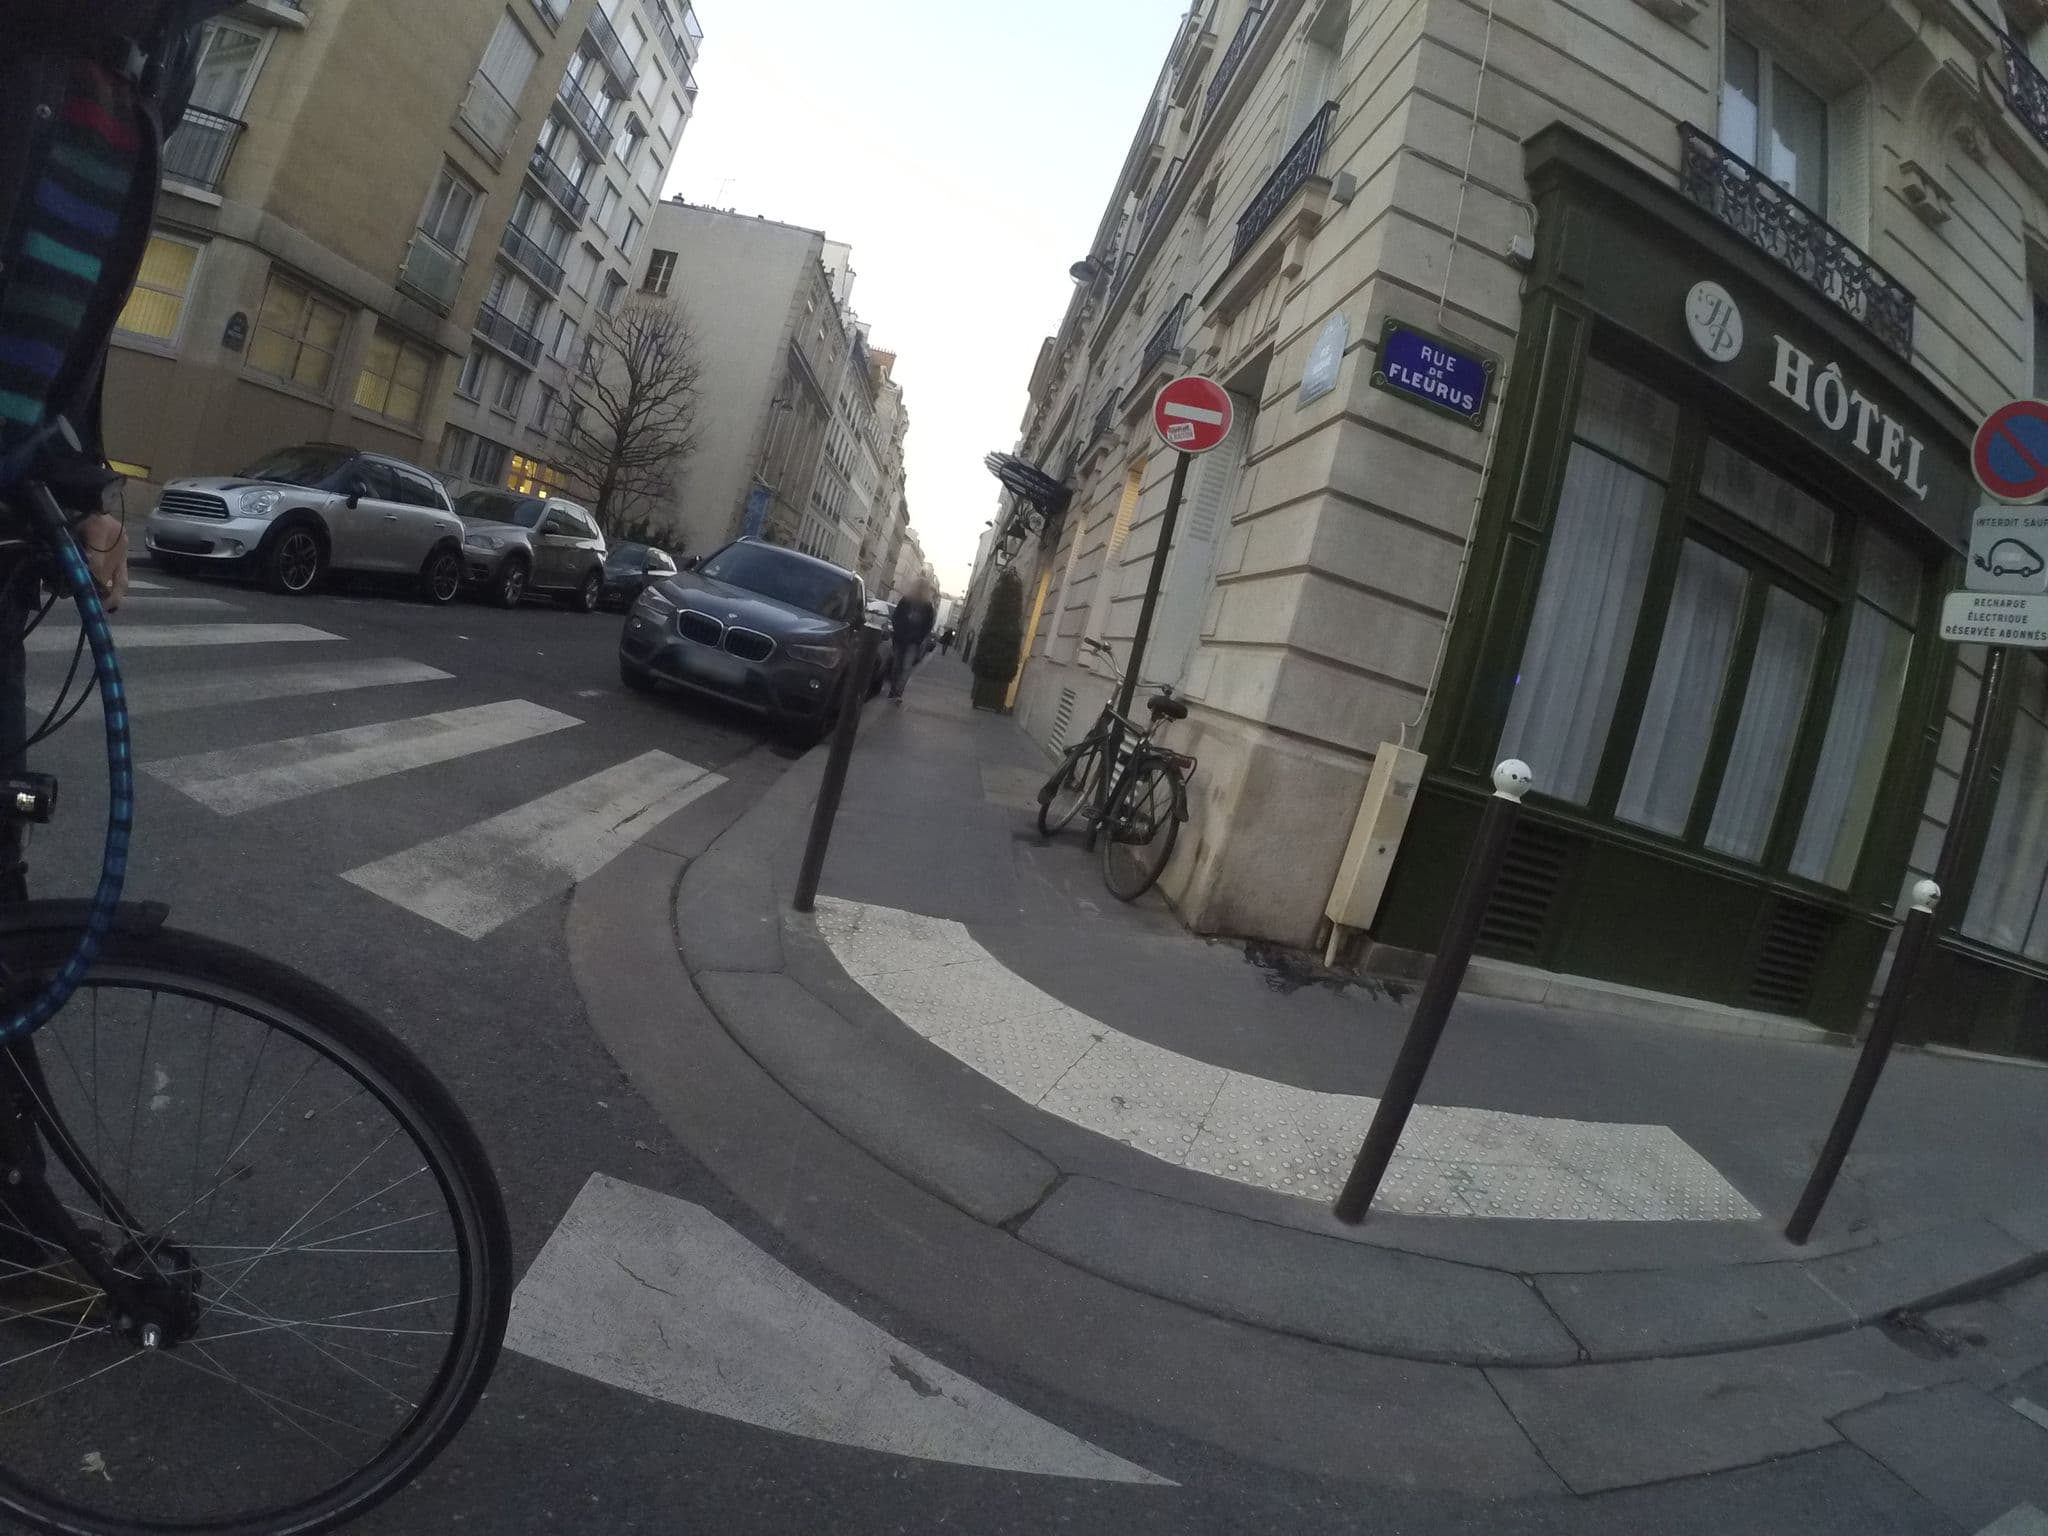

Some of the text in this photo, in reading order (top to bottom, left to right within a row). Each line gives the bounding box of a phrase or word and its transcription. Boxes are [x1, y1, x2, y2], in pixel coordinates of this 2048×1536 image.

[1421, 345, 1457, 372] RUE
[1428, 366, 1443, 379] DE
[1388, 362, 1474, 411] FLEURUS
[1769, 334, 1928, 501] HÔTEL
[1976, 517, 2019, 528] INTERDIT
[1974, 598, 2027, 609] RECHARGE
[1967, 611, 2029, 625] ÉLECTRIQUE
[1945, 625, 2048, 642] RÉSERVÉE ABONNÉS
